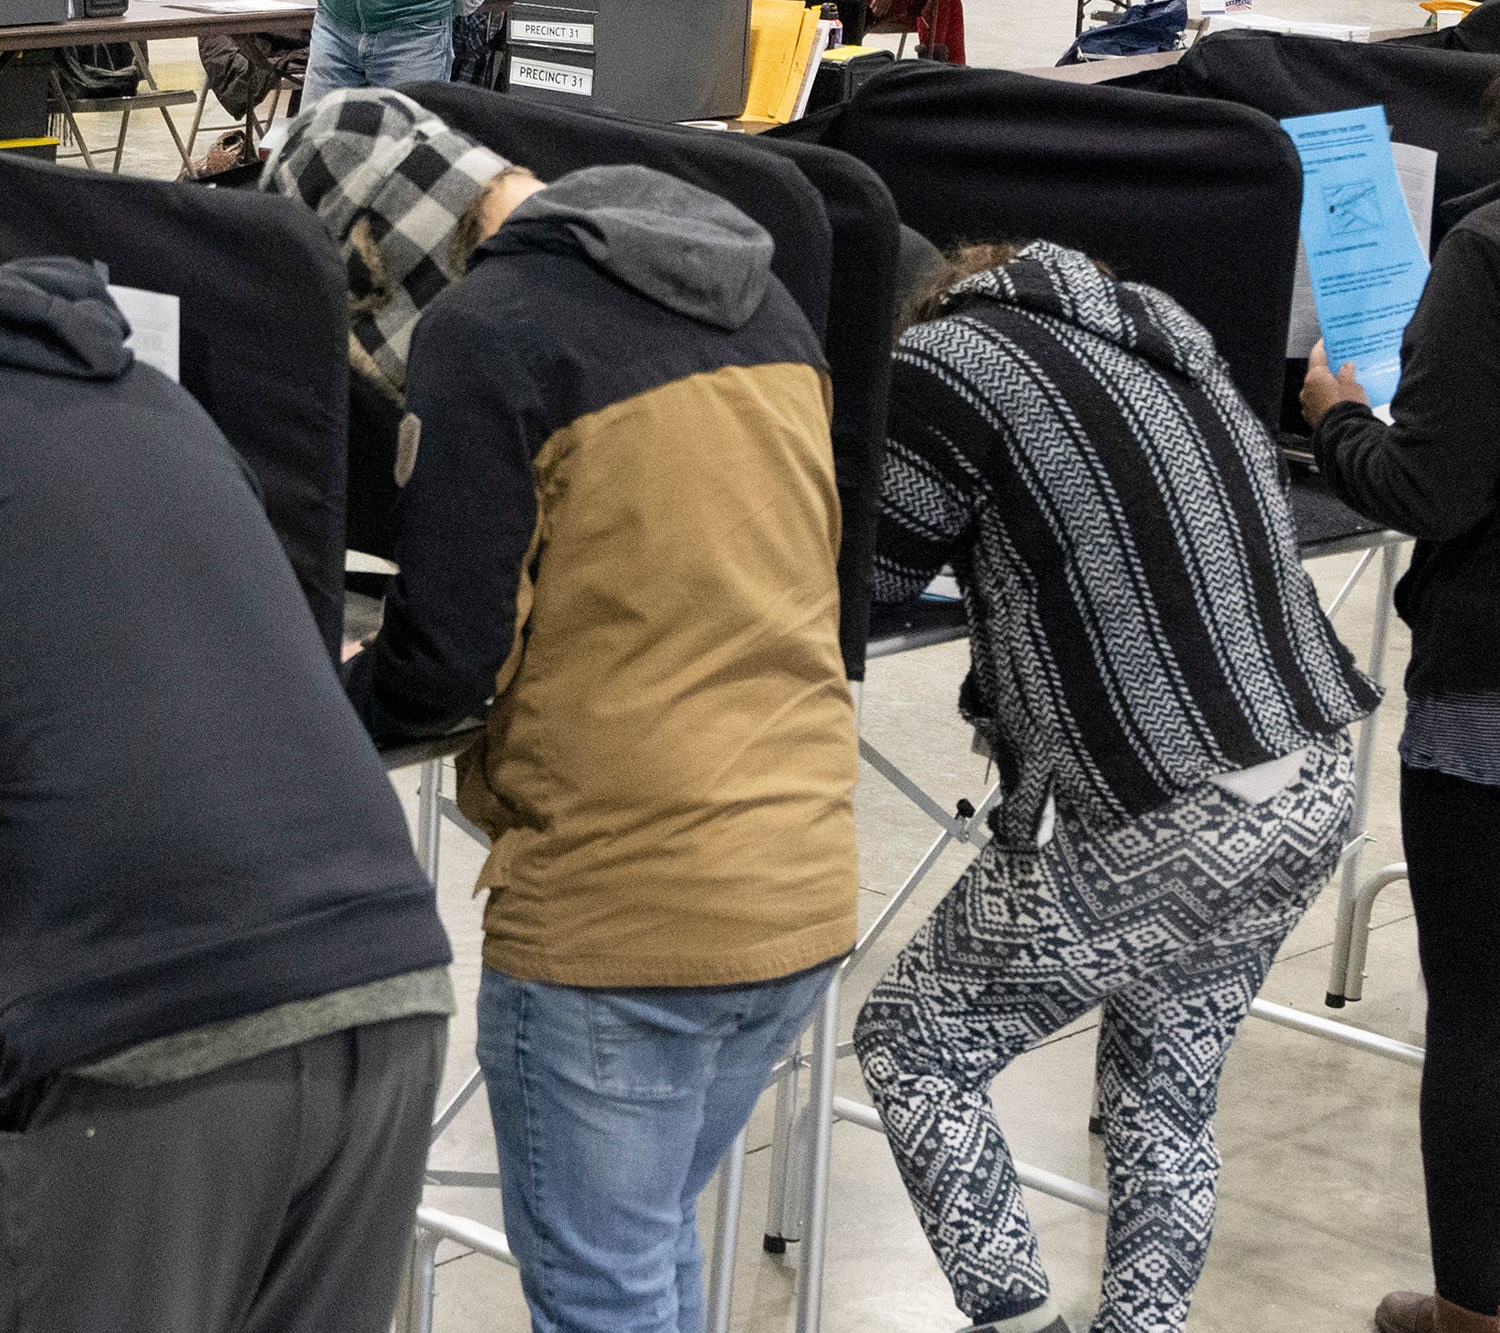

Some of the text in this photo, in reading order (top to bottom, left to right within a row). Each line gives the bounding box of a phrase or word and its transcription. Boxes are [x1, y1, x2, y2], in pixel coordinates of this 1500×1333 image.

[525, 24, 579, 38] PRECINCT 31
[520, 66, 583, 87] PRECINCT 31
